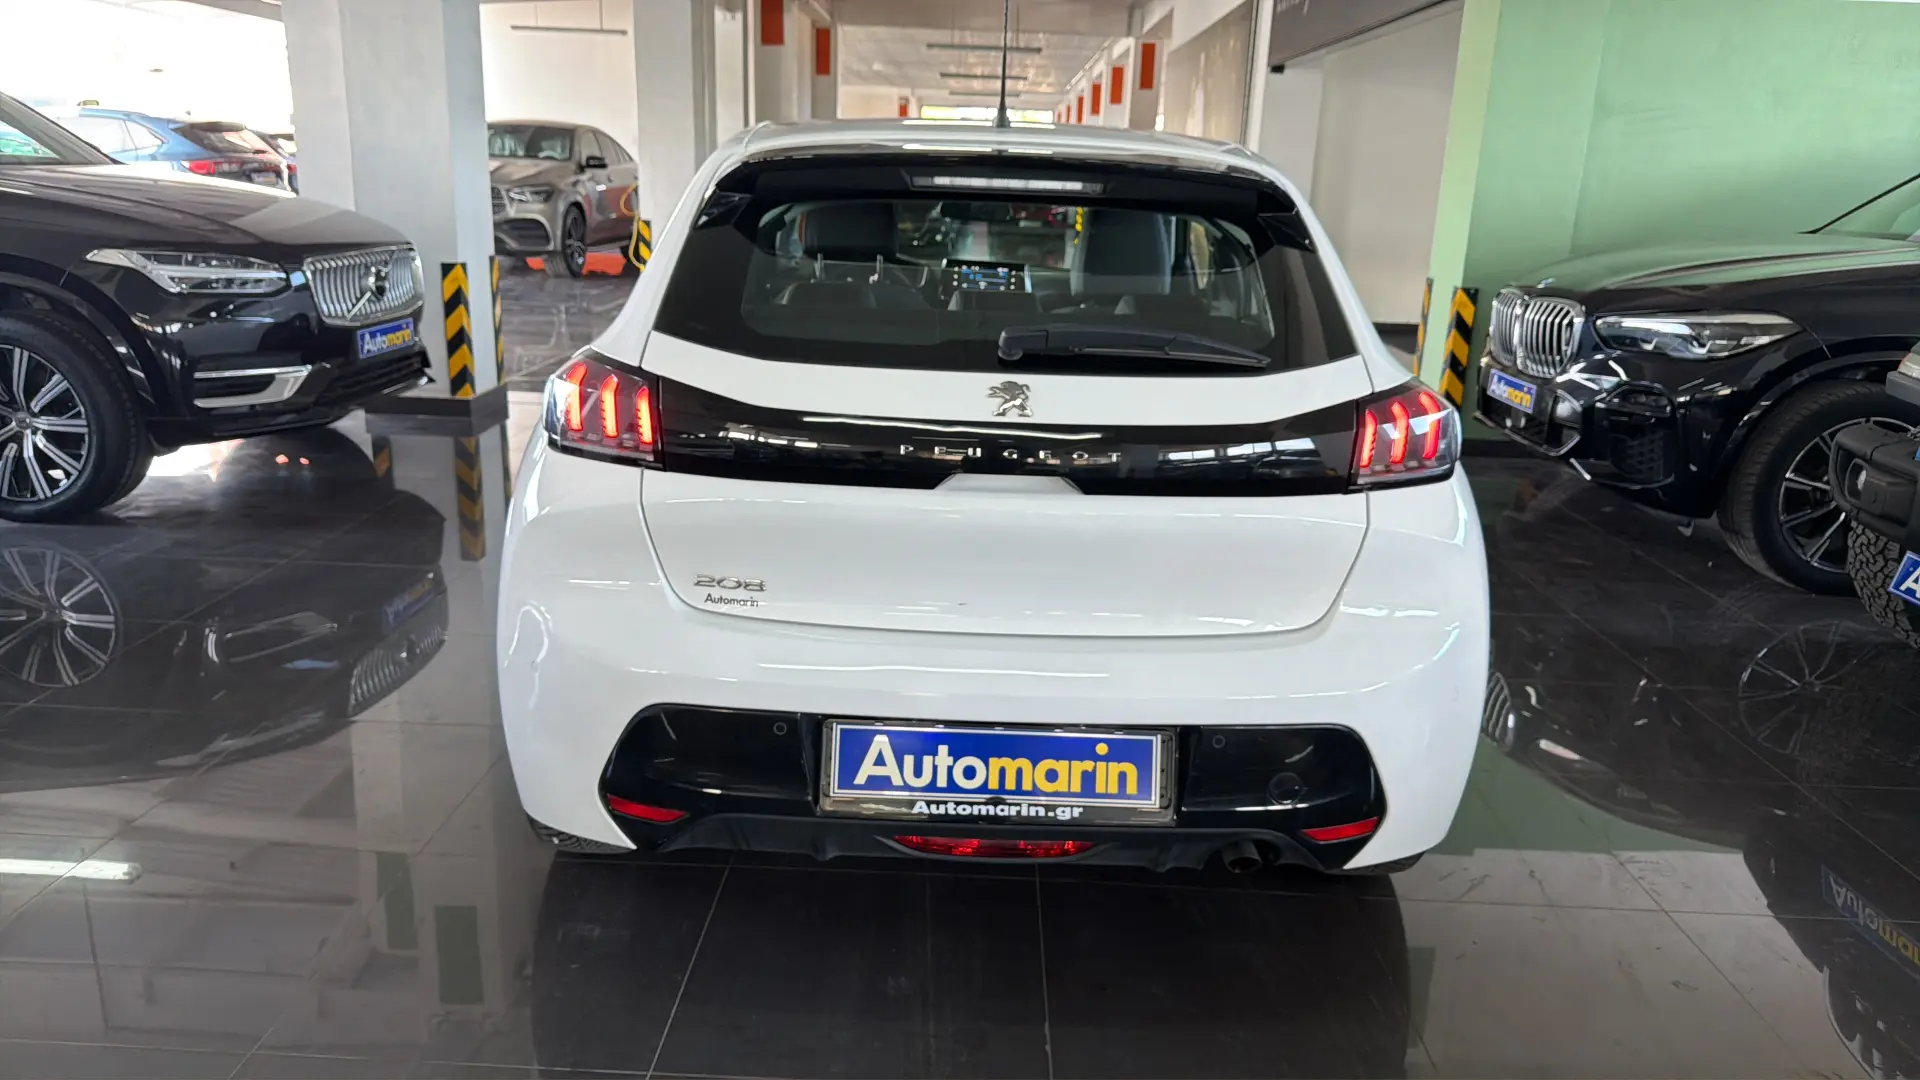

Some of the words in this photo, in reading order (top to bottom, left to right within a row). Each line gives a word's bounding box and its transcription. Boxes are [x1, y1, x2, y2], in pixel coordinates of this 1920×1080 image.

[363, 323, 411, 355] Automarin
[900, 444, 1121, 463] PEUGEOT
[693, 573, 766, 592] 208
[704, 592, 759, 608] Automarin
[853, 734, 1138, 795] Automarin
[911, 800, 1084, 820] Automarin.gr
